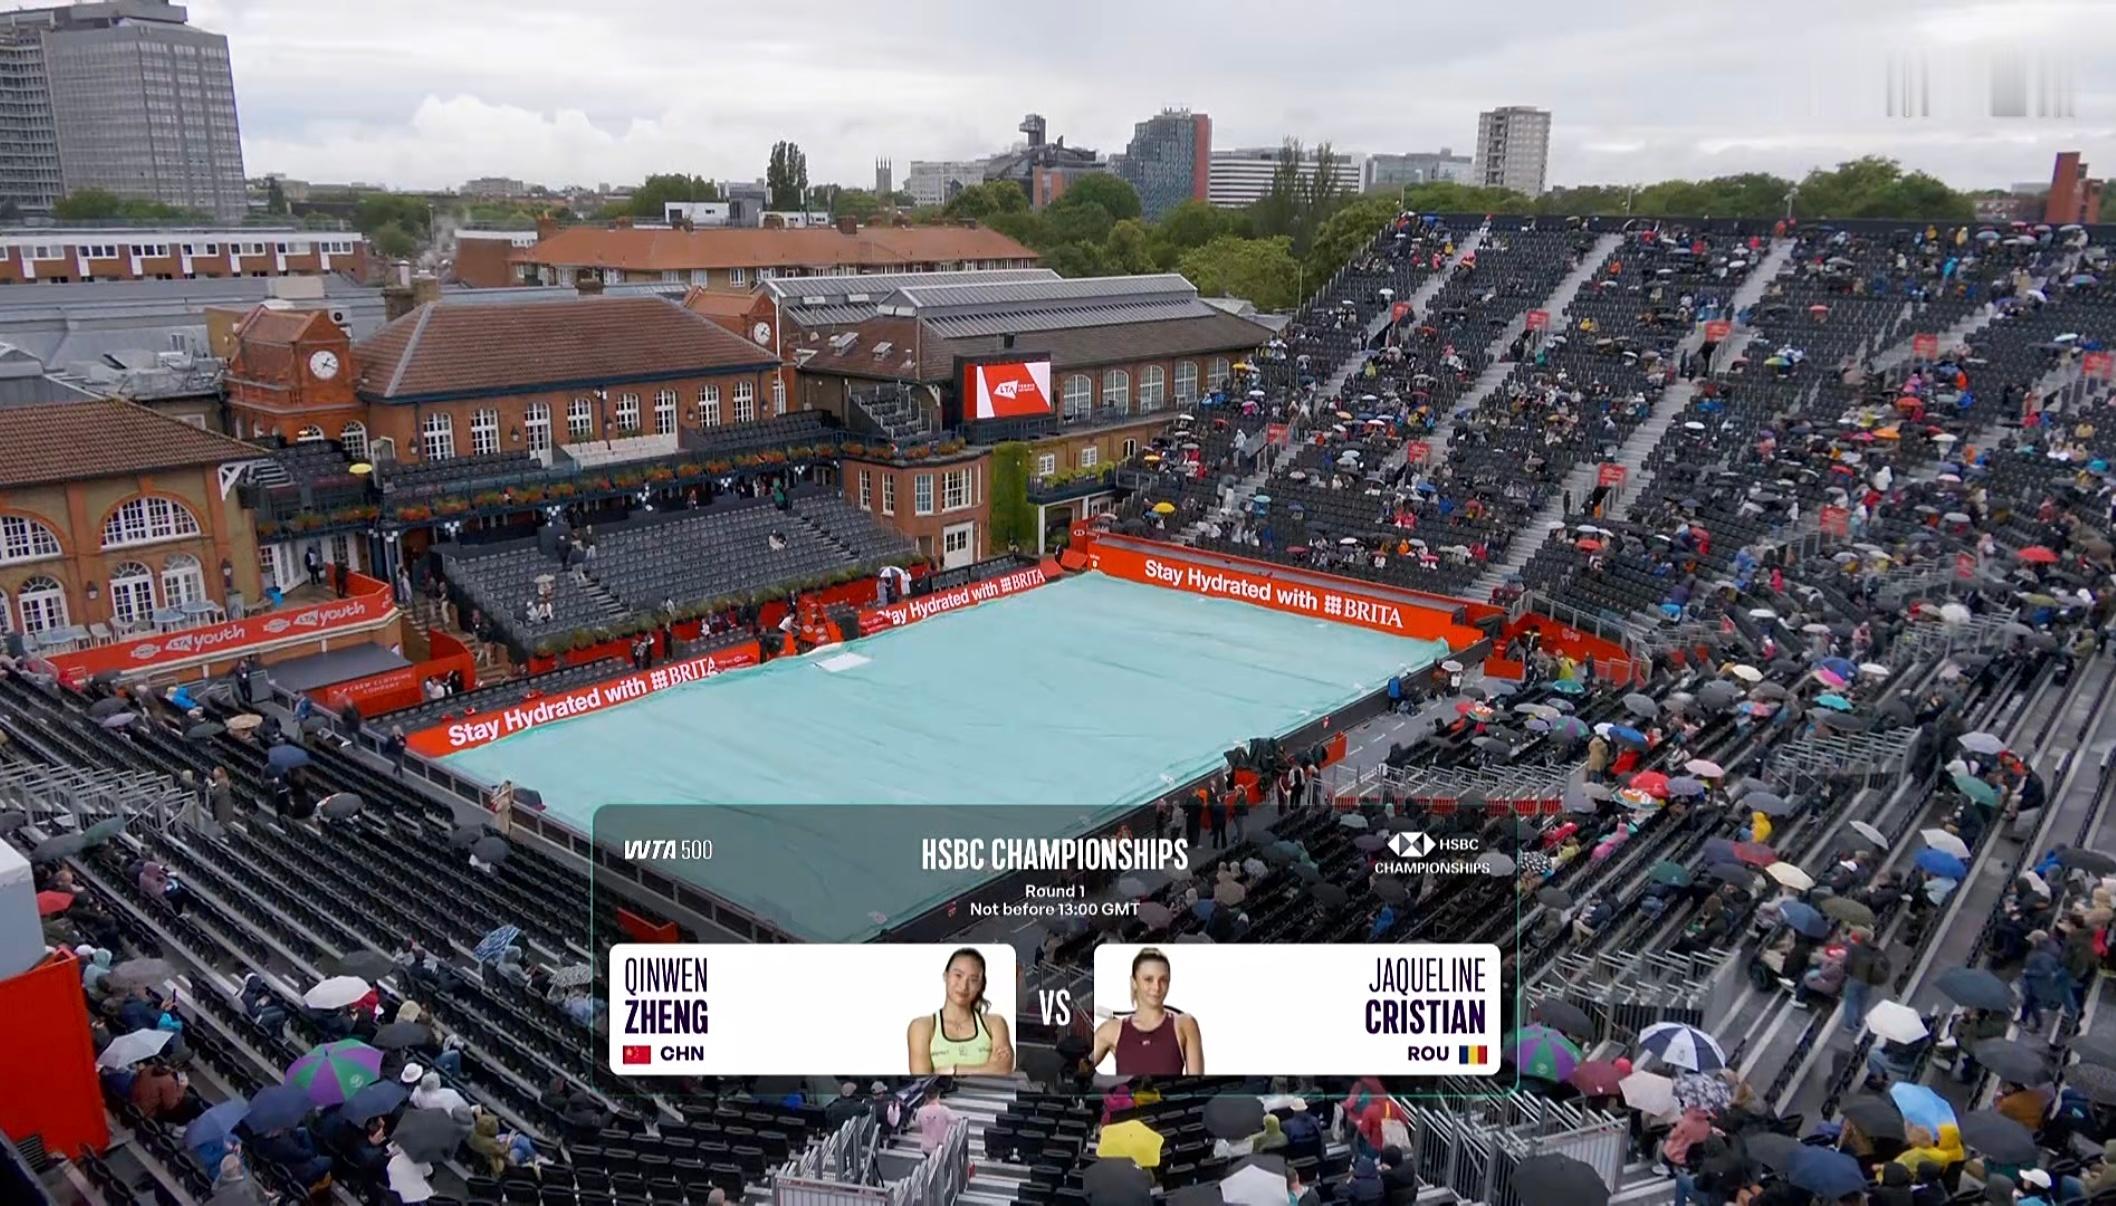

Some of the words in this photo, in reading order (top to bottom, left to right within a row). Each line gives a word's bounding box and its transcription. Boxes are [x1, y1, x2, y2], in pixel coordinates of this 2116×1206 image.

[320, 601, 365, 626] youth
[909, 590, 970, 619] Hydrated
[972, 583, 998, 600] with
[1012, 568, 1045, 591] BRITA
[1144, 560, 1183, 586] Stay
[1188, 570, 1271, 601] Hydrated
[1277, 588, 1318, 611] with
[1344, 599, 1404, 629] BRITA
[194, 624, 245, 652] youth
[448, 719, 500, 747] Stay
[504, 690, 600, 731] Hydrated
[605, 676, 647, 700] with
[667, 656, 717, 685] BRITA
